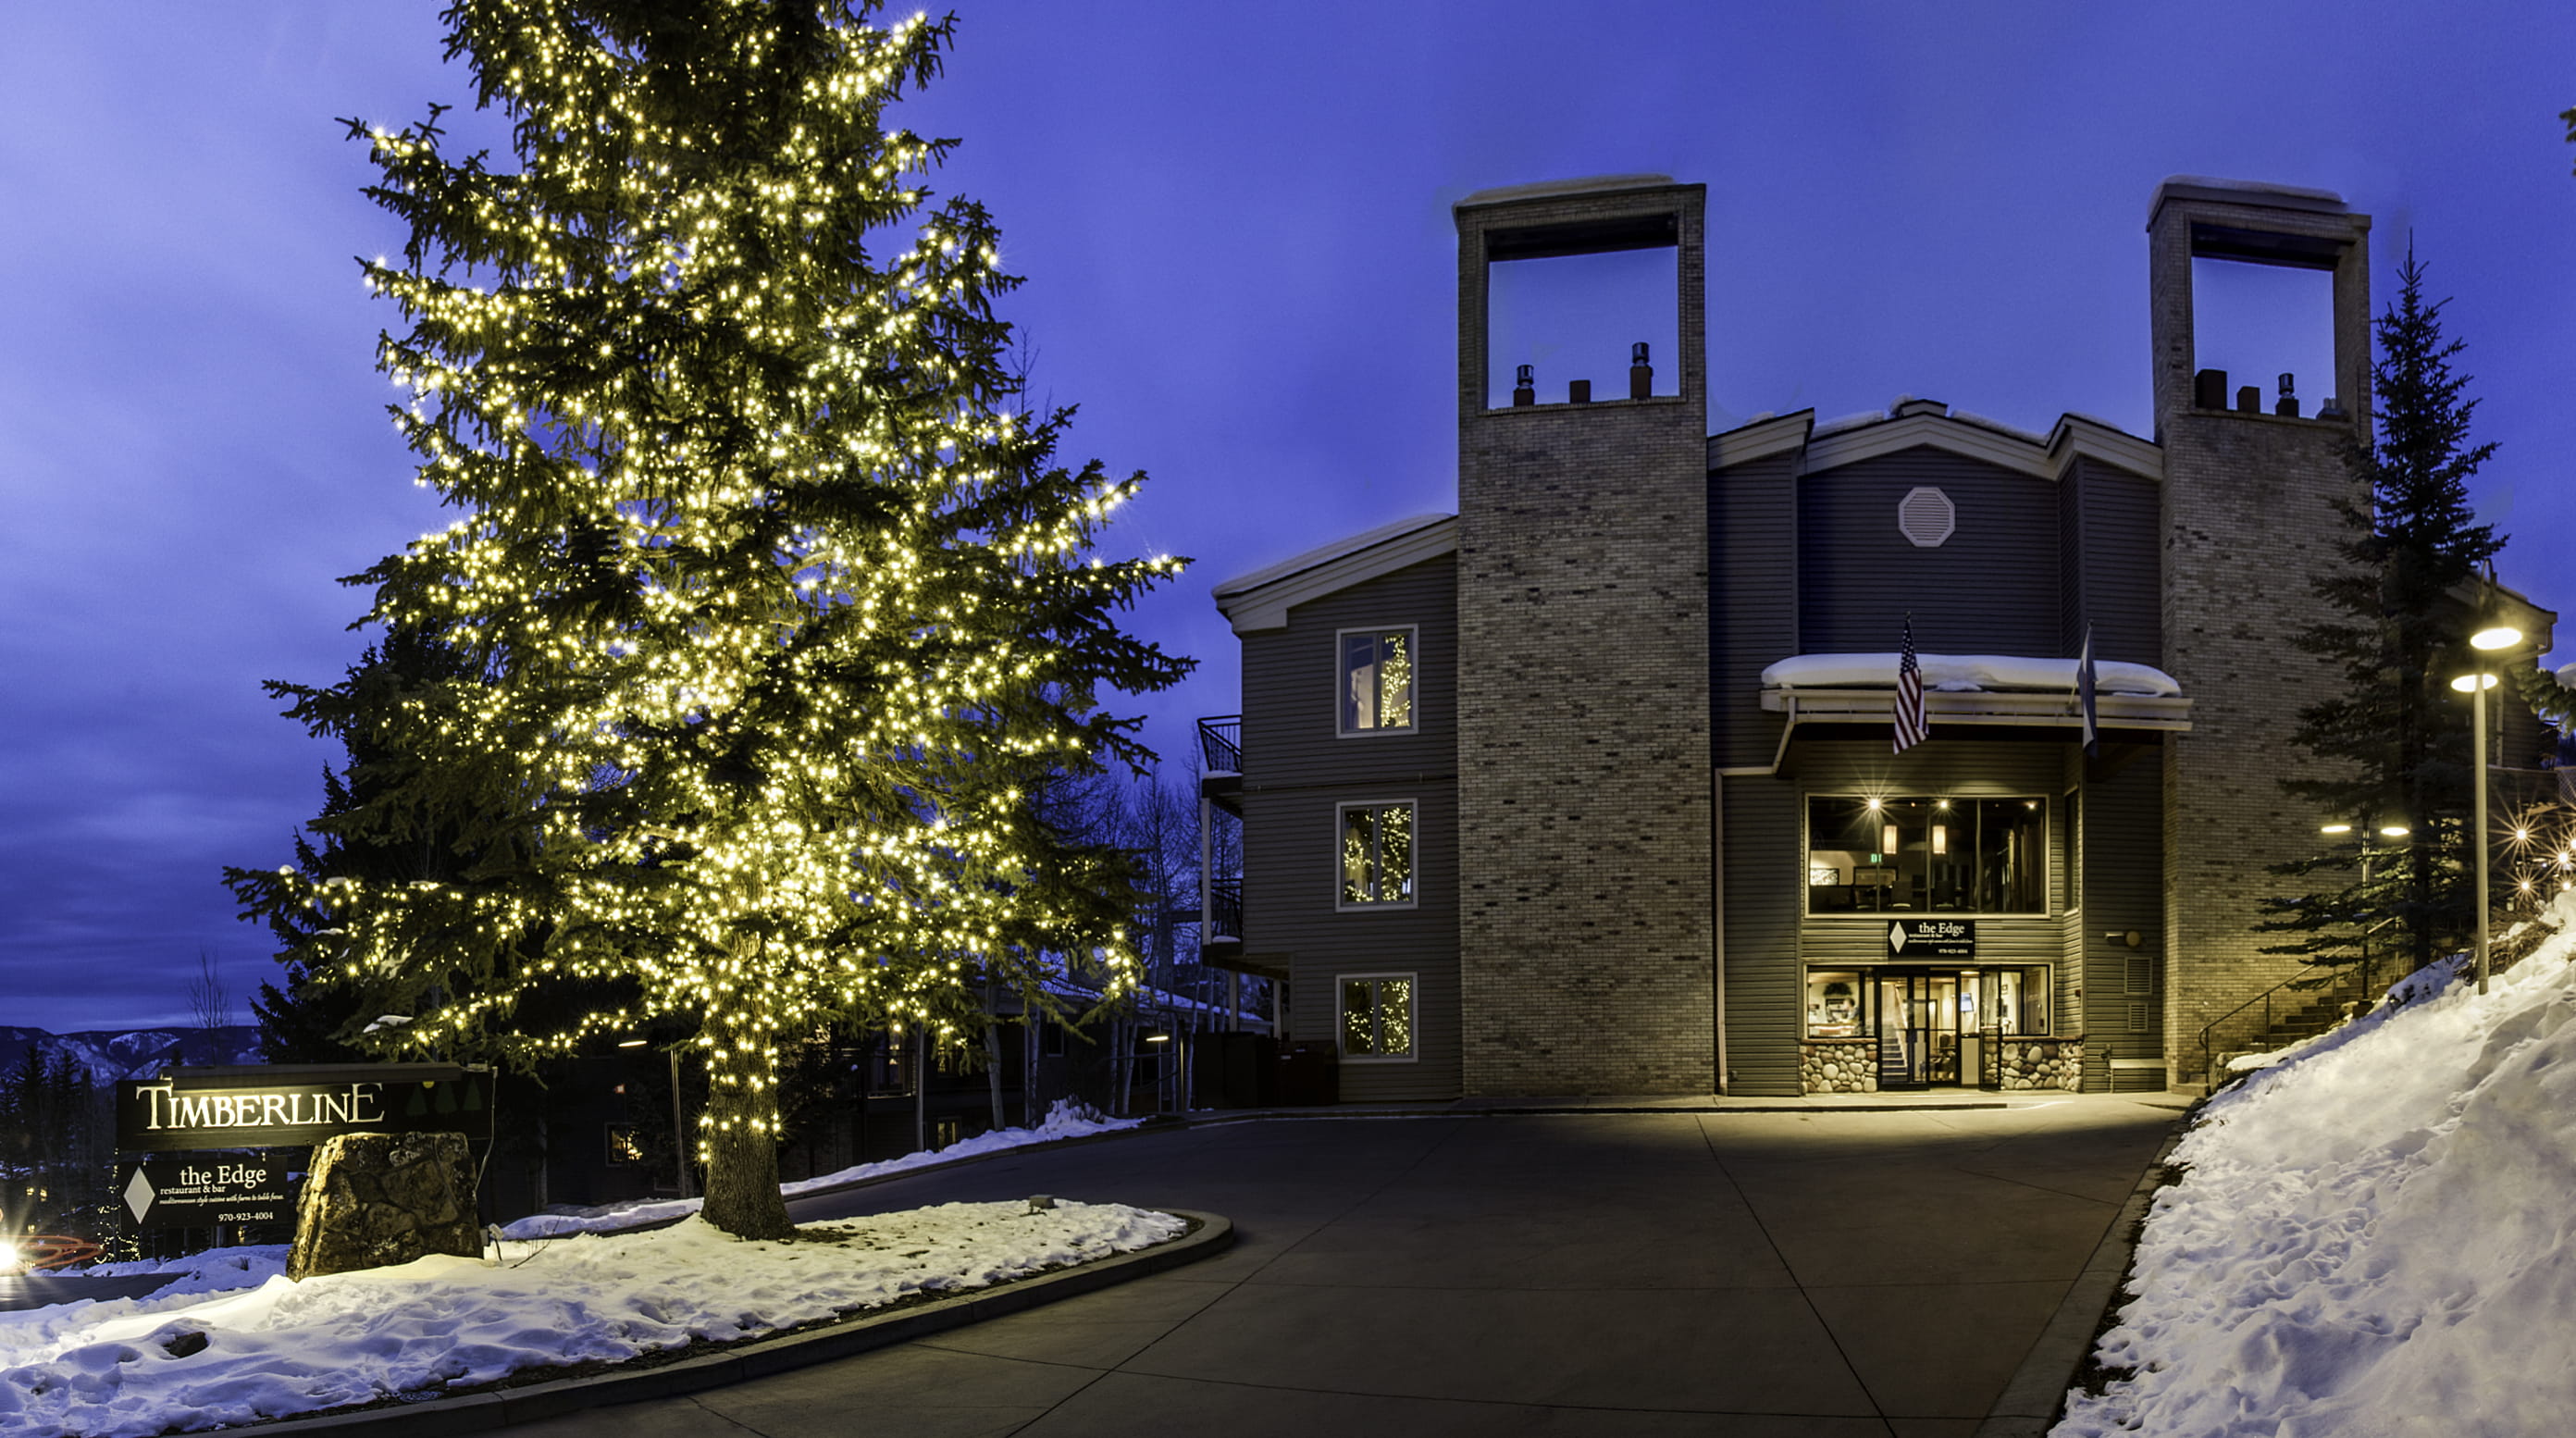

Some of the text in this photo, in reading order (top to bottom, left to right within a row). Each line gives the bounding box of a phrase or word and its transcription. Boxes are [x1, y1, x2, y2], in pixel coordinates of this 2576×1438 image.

[1919, 923, 1937, 934] the
[1938, 922, 1965, 936] Edge
[136, 1083, 385, 1130] TIMBERLINE
[180, 1163, 267, 1189] the Edge
[160, 1184, 227, 1195] restaurant & bar
[218, 1211, 274, 1221] 970-923-4004
